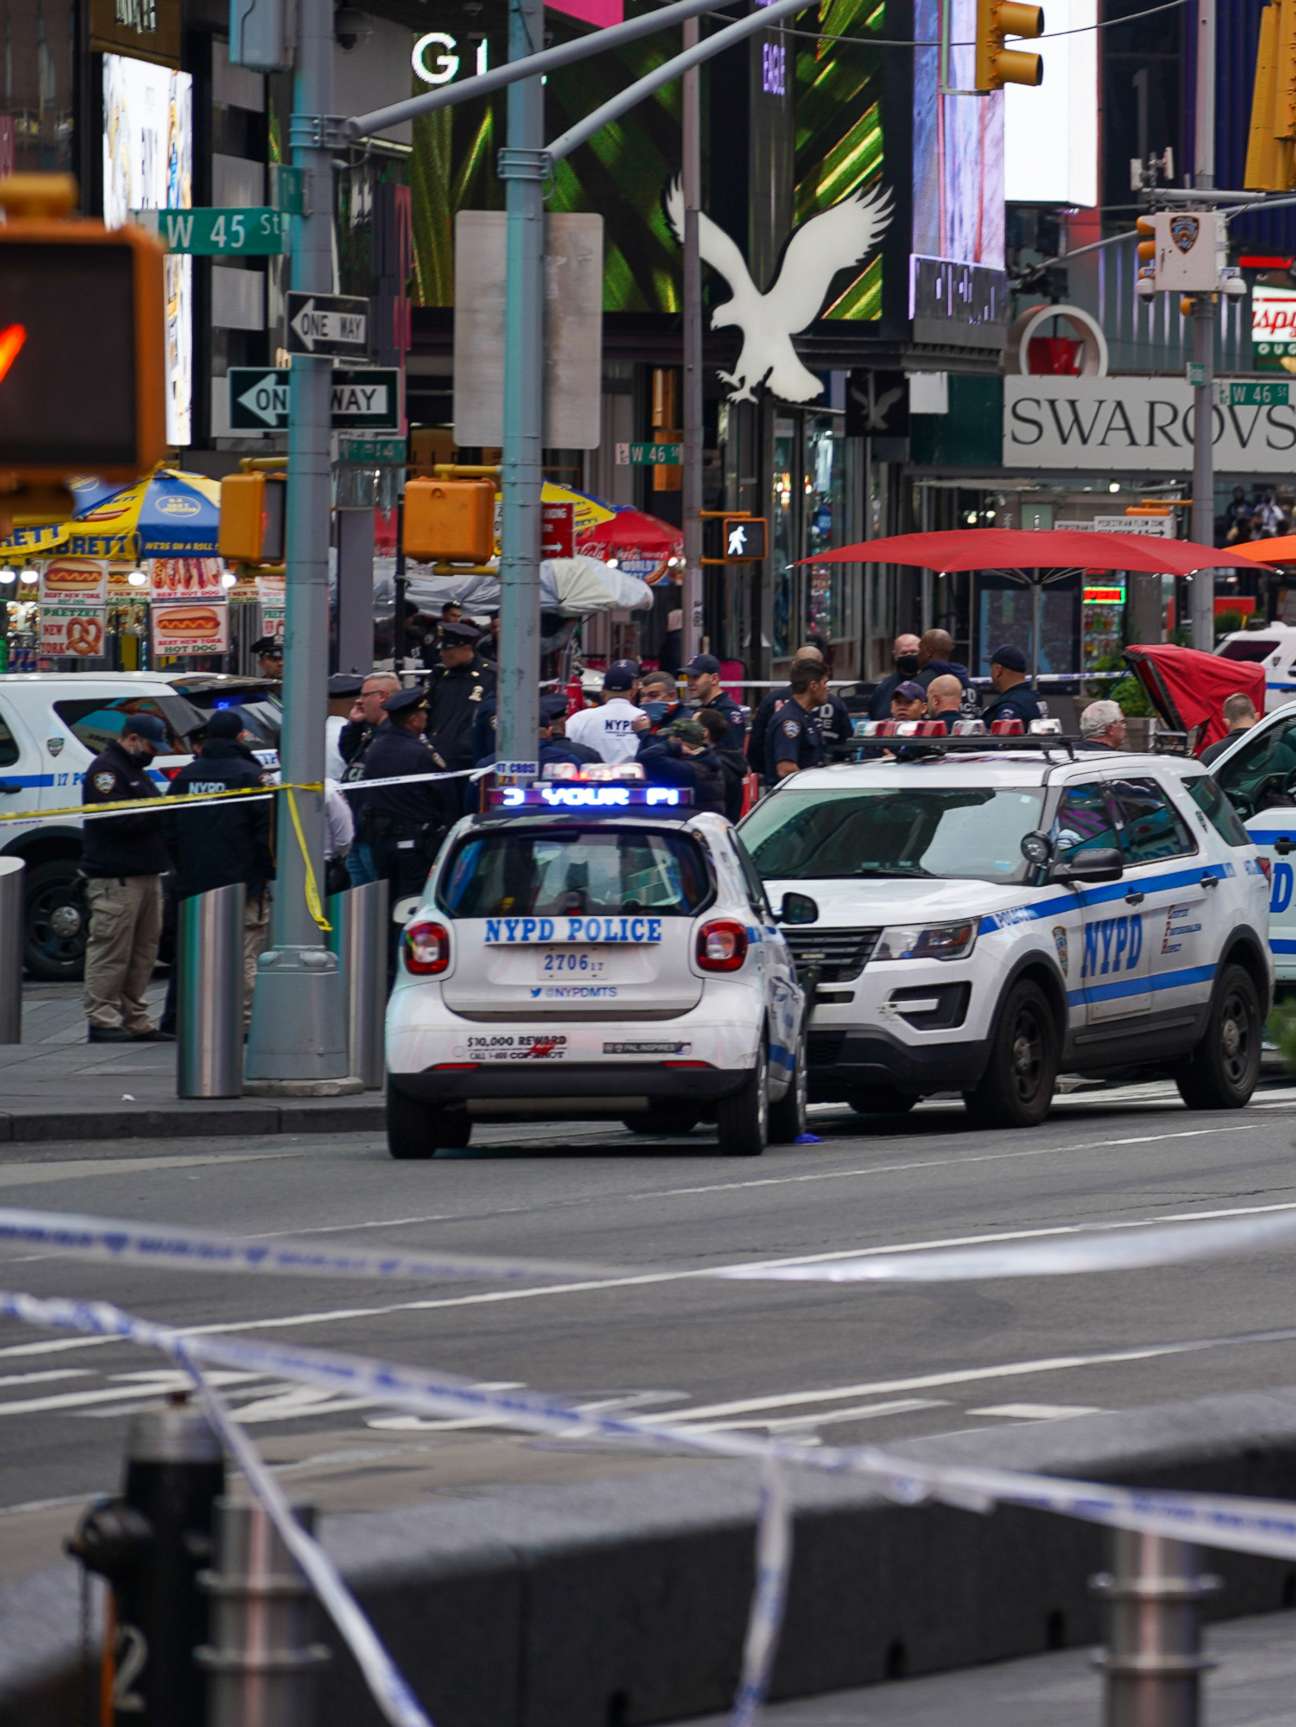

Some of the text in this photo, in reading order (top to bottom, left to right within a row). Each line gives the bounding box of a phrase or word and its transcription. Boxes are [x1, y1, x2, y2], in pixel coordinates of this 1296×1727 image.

[166, 213, 281, 248] W 45 St
[301, 313, 362, 338] ONE WAY
[255, 388, 288, 411] ON
[1232, 387, 1289, 402] W 46 St
[631, 447, 643, 462] W
[649, 447, 665, 462] 46
[604, 719, 632, 730] NYP
[188, 781, 226, 794] NYPD
[541, 787, 630, 806] YOUR
[484, 919, 662, 943] NYPD POLICE
[1080, 914, 1143, 978] NYPD
[544, 954, 588, 971] 2706
[546, 986, 618, 998] @NYPDMTS
[467, 1036, 567, 1048] $10,000 REWARD
